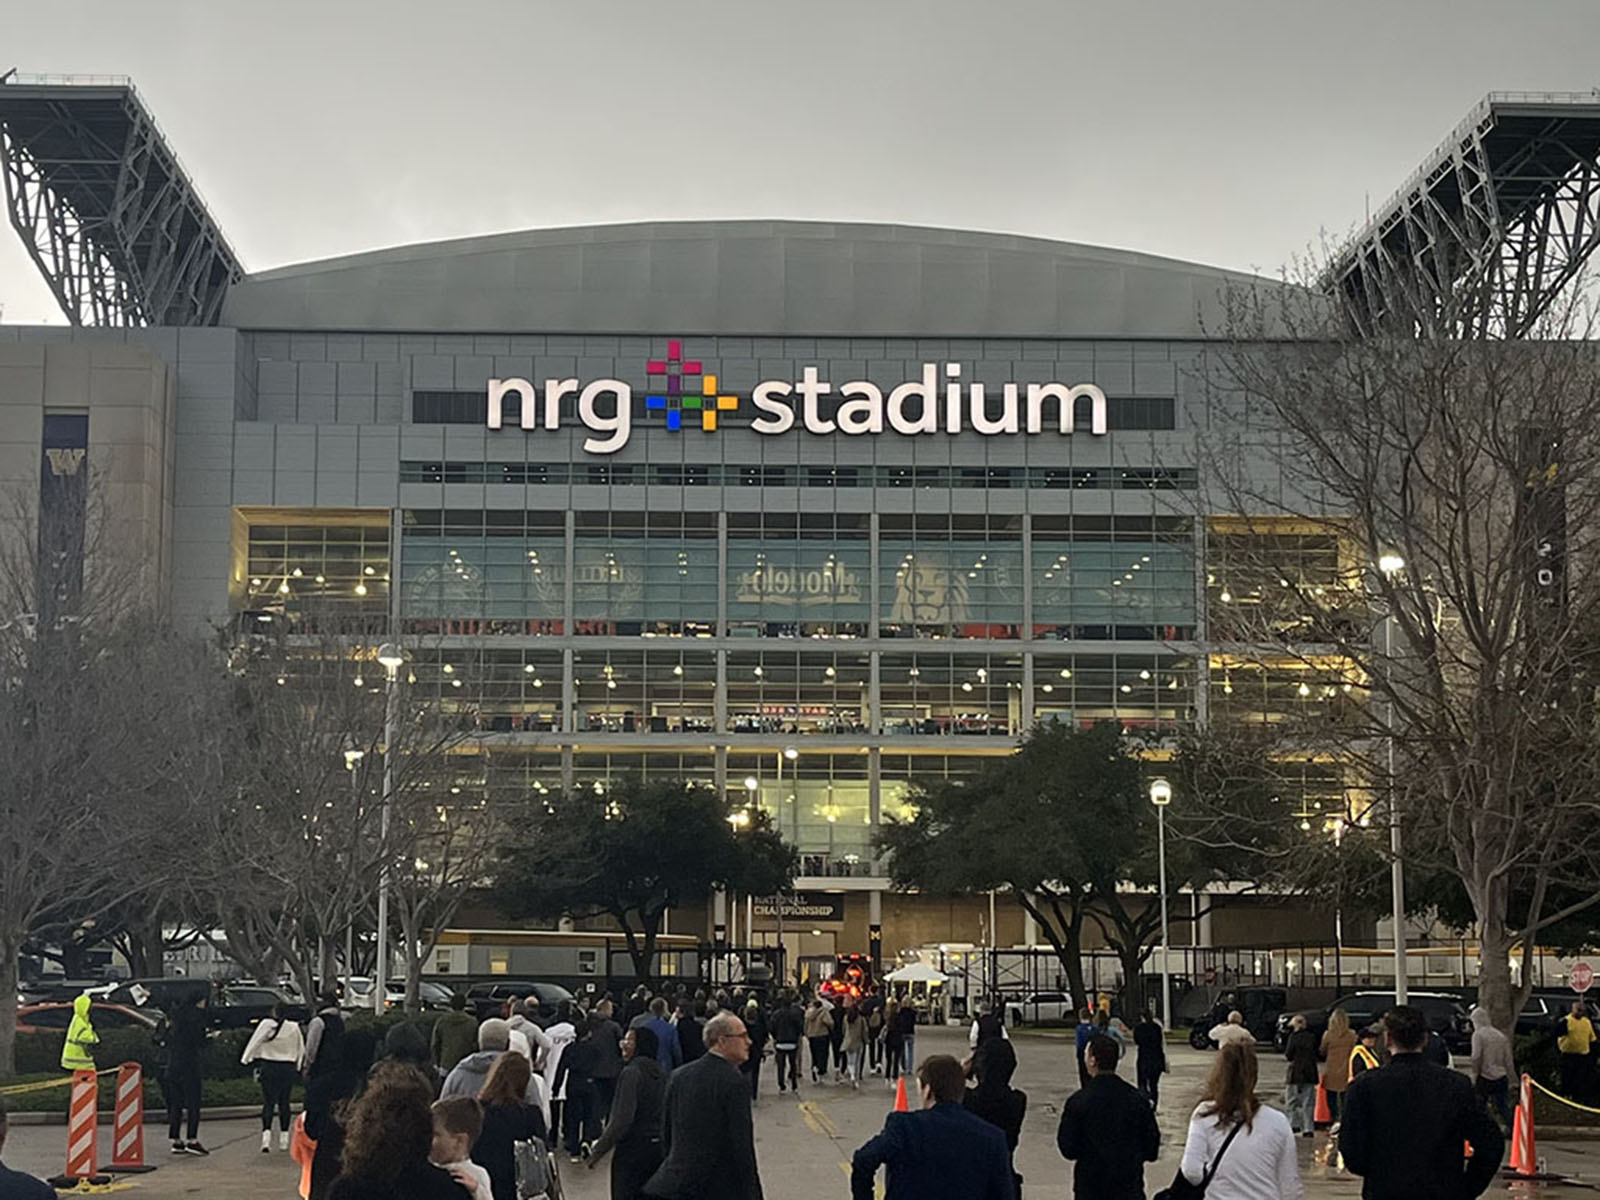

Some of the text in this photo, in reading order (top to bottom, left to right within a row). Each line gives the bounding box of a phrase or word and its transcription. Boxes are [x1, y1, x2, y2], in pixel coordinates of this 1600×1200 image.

[486, 362, 1108, 455] nrg stadium
[45, 448, 86, 476] W
